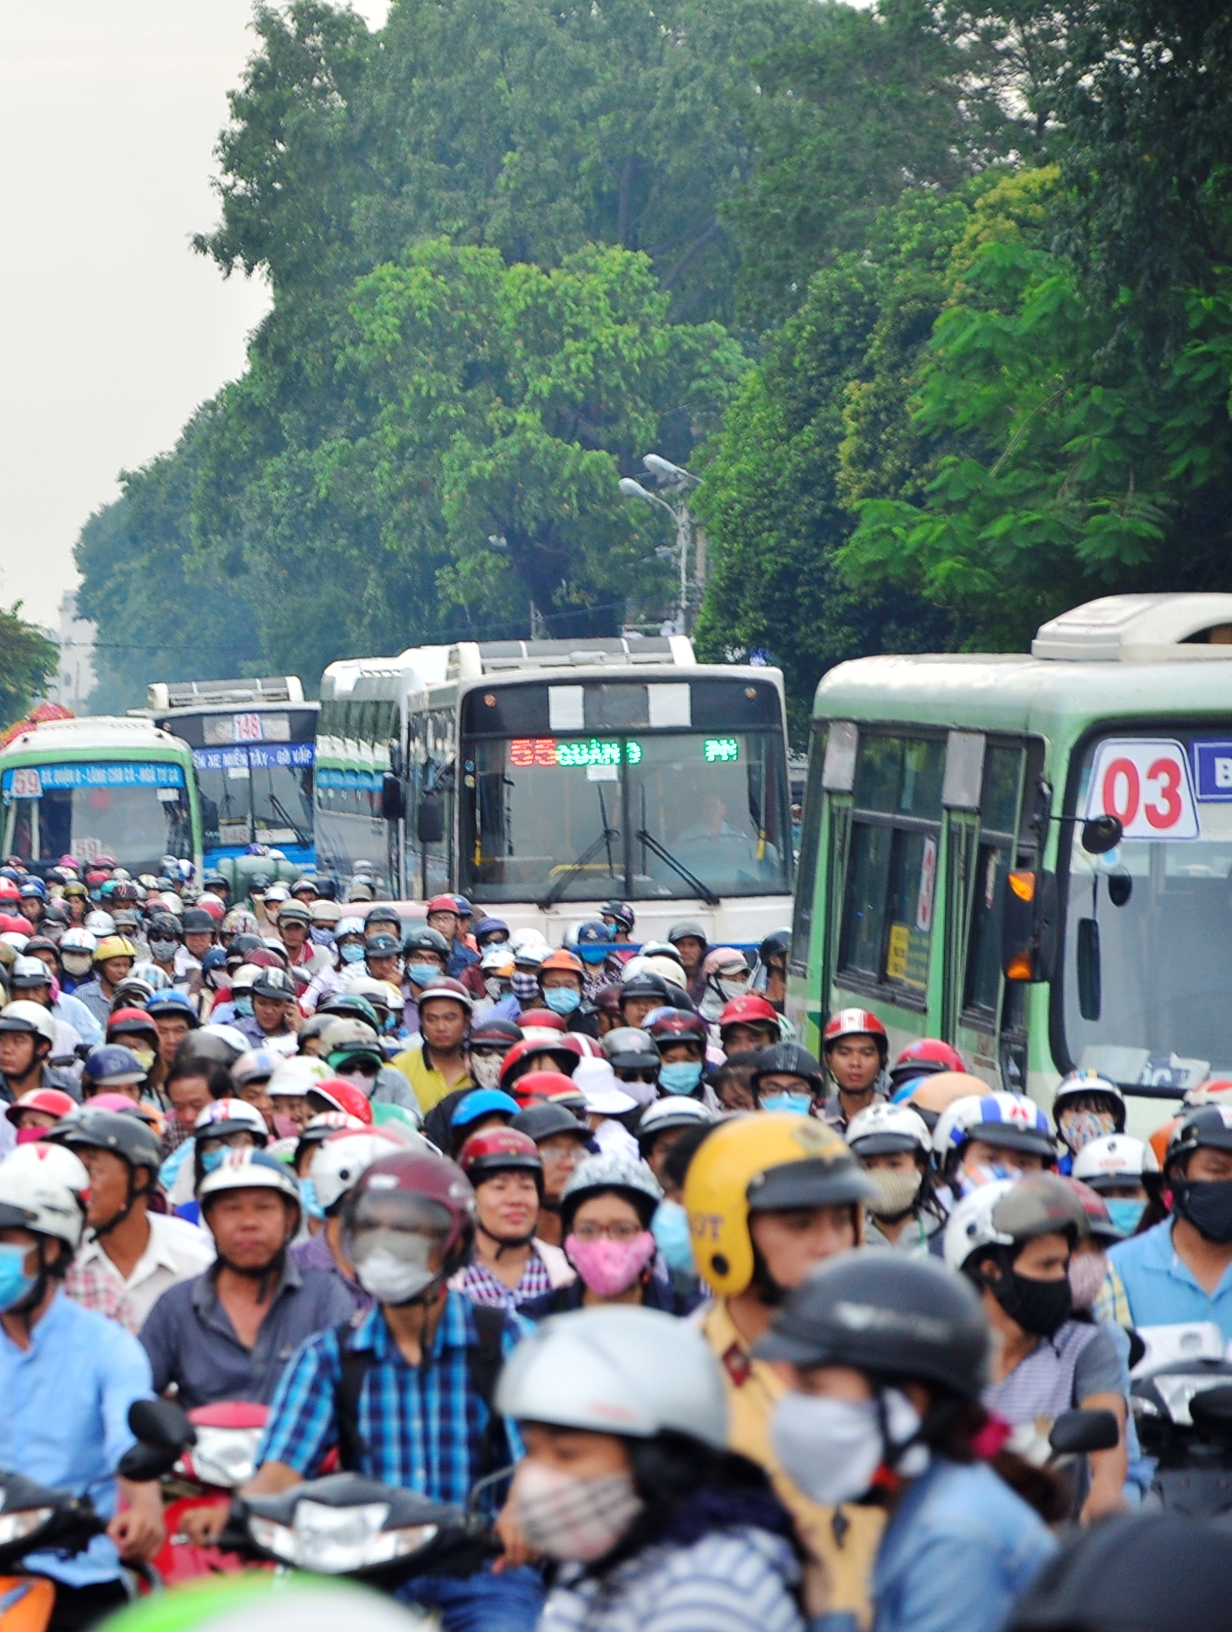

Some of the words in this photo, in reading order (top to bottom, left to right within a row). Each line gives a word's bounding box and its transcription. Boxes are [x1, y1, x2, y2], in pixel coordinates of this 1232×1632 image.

[236, 713, 260, 739] 148
[207, 753, 222, 768] XE
[14, 769, 40, 795] 59
[1103, 757, 1182, 829] 03
